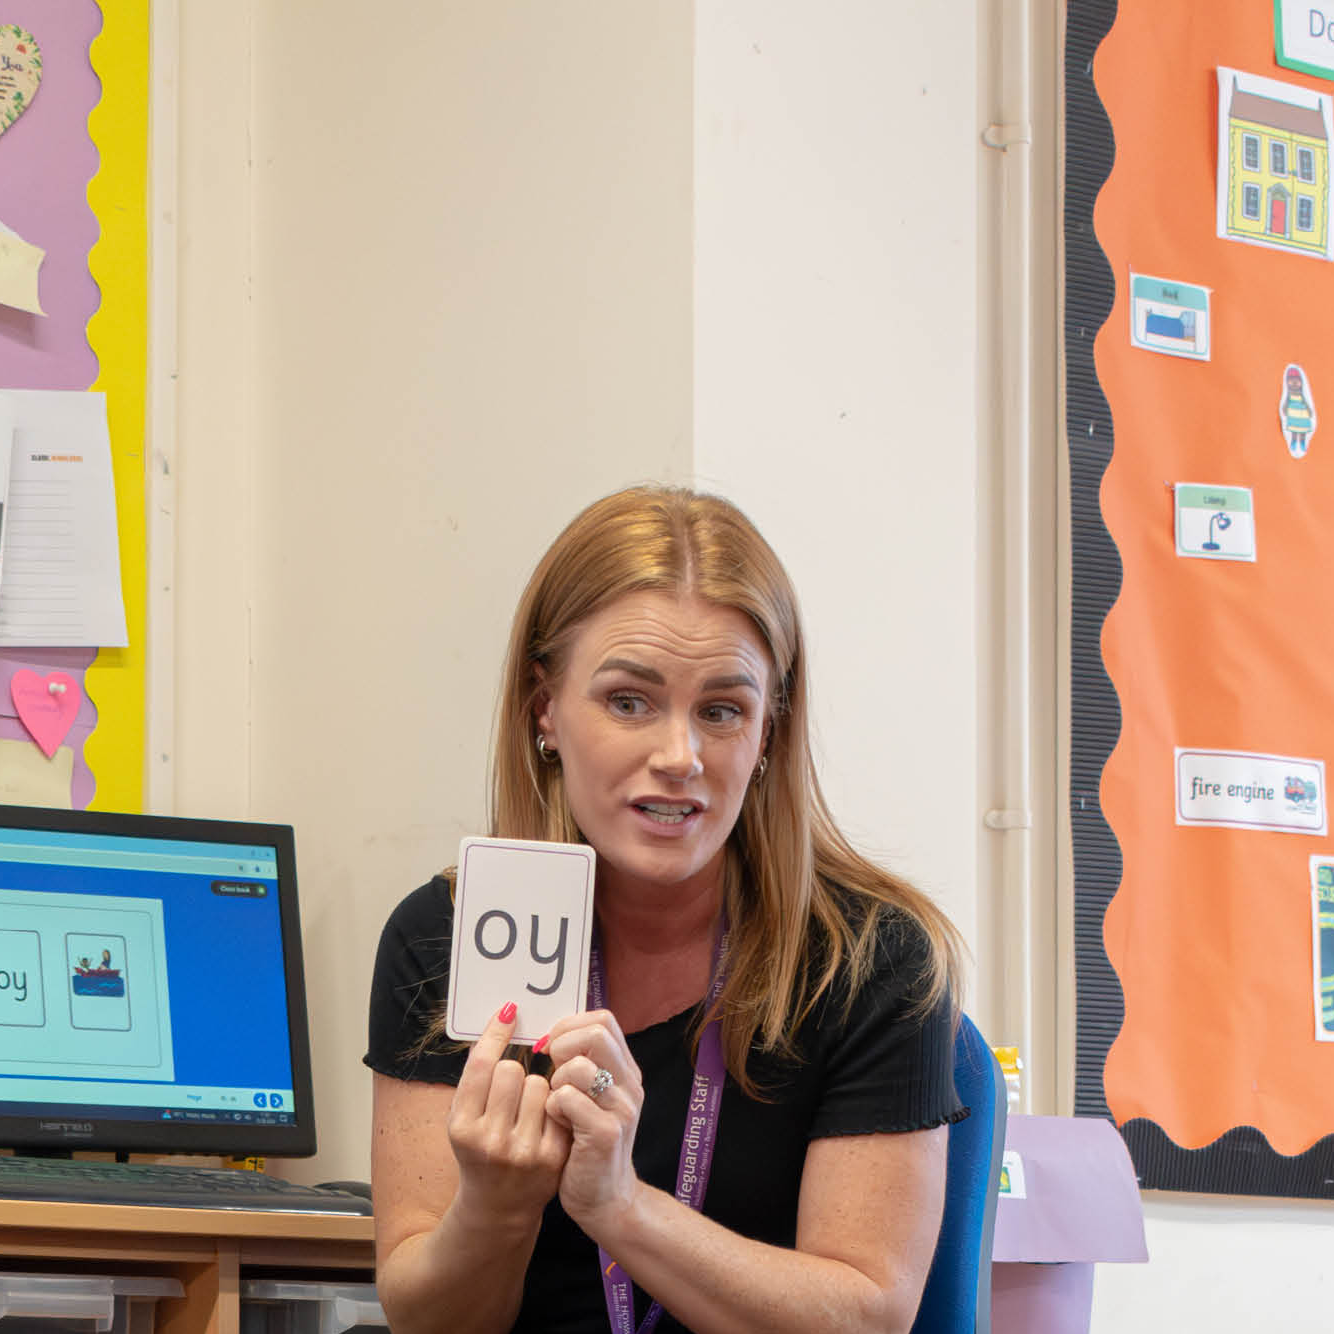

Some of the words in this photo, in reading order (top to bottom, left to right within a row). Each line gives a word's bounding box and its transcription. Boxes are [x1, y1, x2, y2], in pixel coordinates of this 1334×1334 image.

[1190, 777, 1221, 800] fire
[1227, 782, 1274, 802] engine
[474, 910, 569, 995] oy
[691, 1073, 710, 1112] Staff
[678, 1117, 706, 1205] feguarding
[618, 1283, 628, 1303] THE
